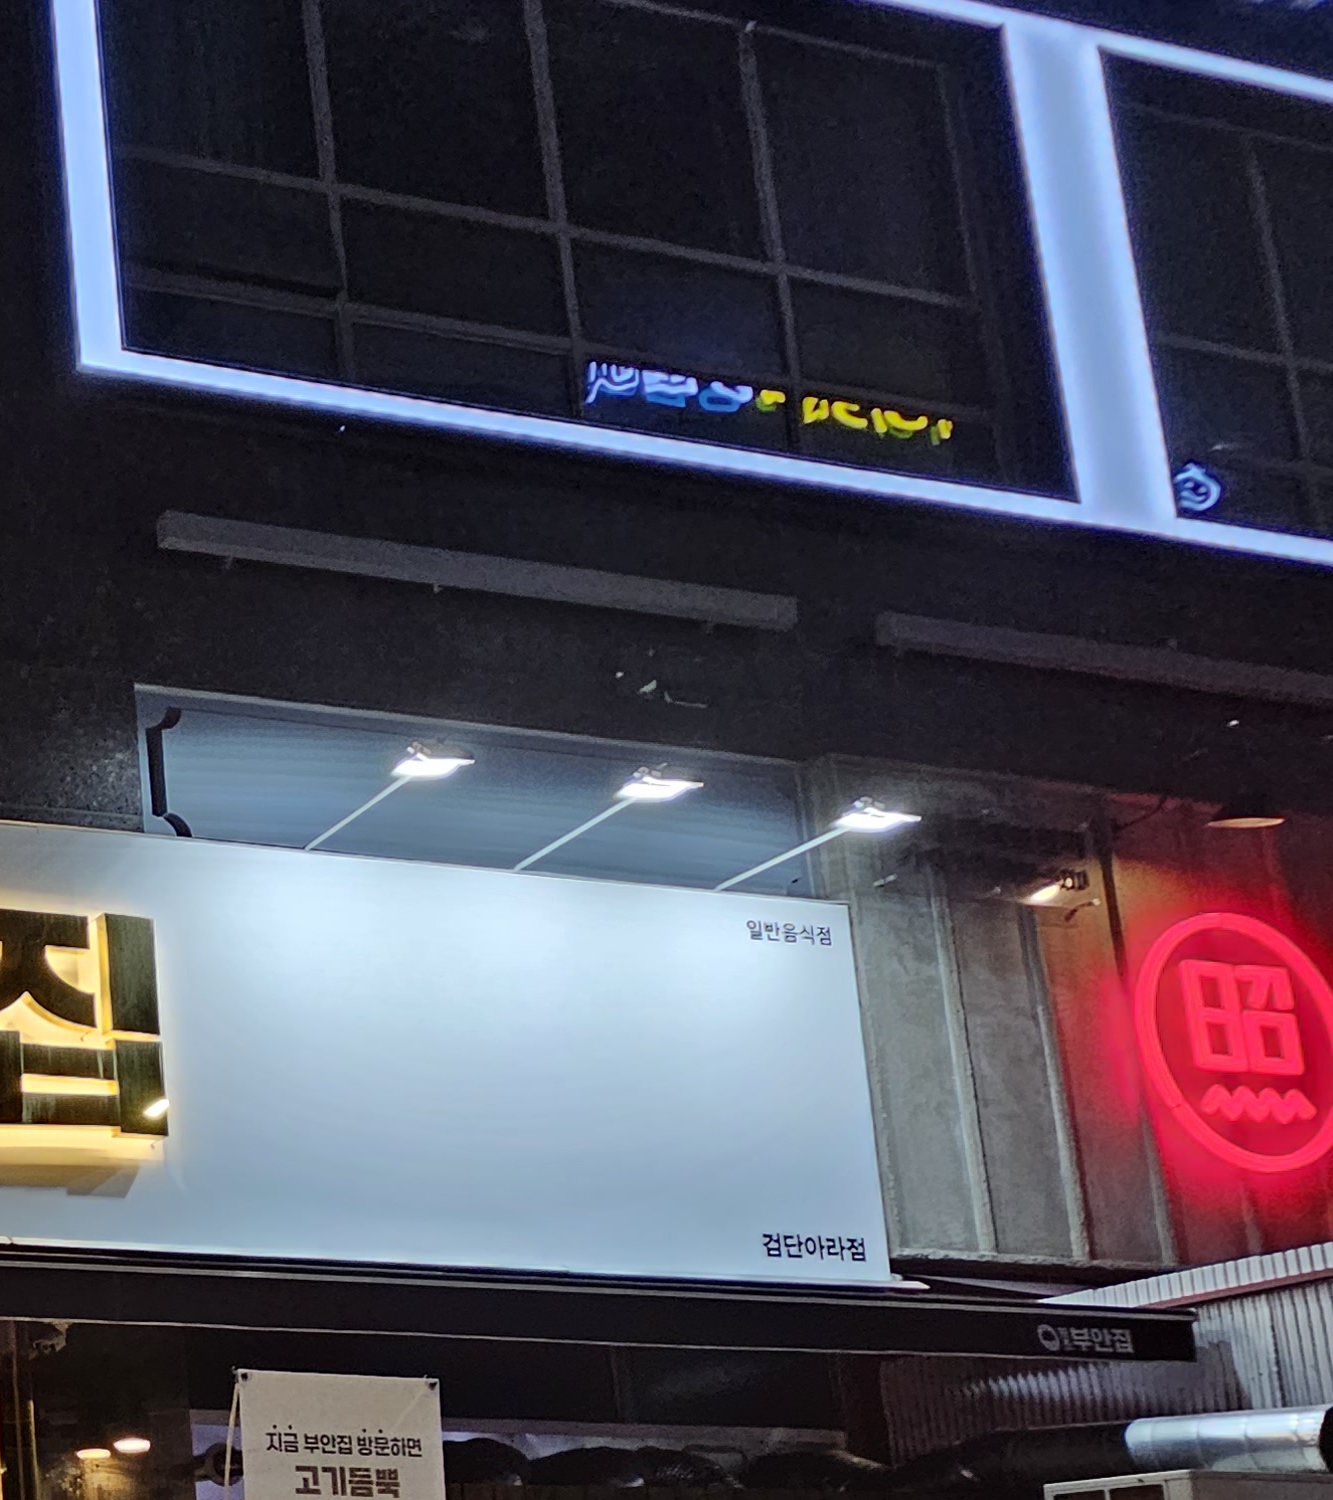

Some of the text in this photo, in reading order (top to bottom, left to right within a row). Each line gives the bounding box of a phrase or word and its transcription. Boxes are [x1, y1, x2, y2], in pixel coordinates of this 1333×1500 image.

[745, 918, 833, 947] 일반음식점
[762, 1232, 867, 1262] 검단아라점
[1069, 1327, 1135, 1353] 부안집
[265, 1431, 423, 1458] 지금 부안집 방문하면
[294, 1465, 401, 1498] 고기듬뿍
